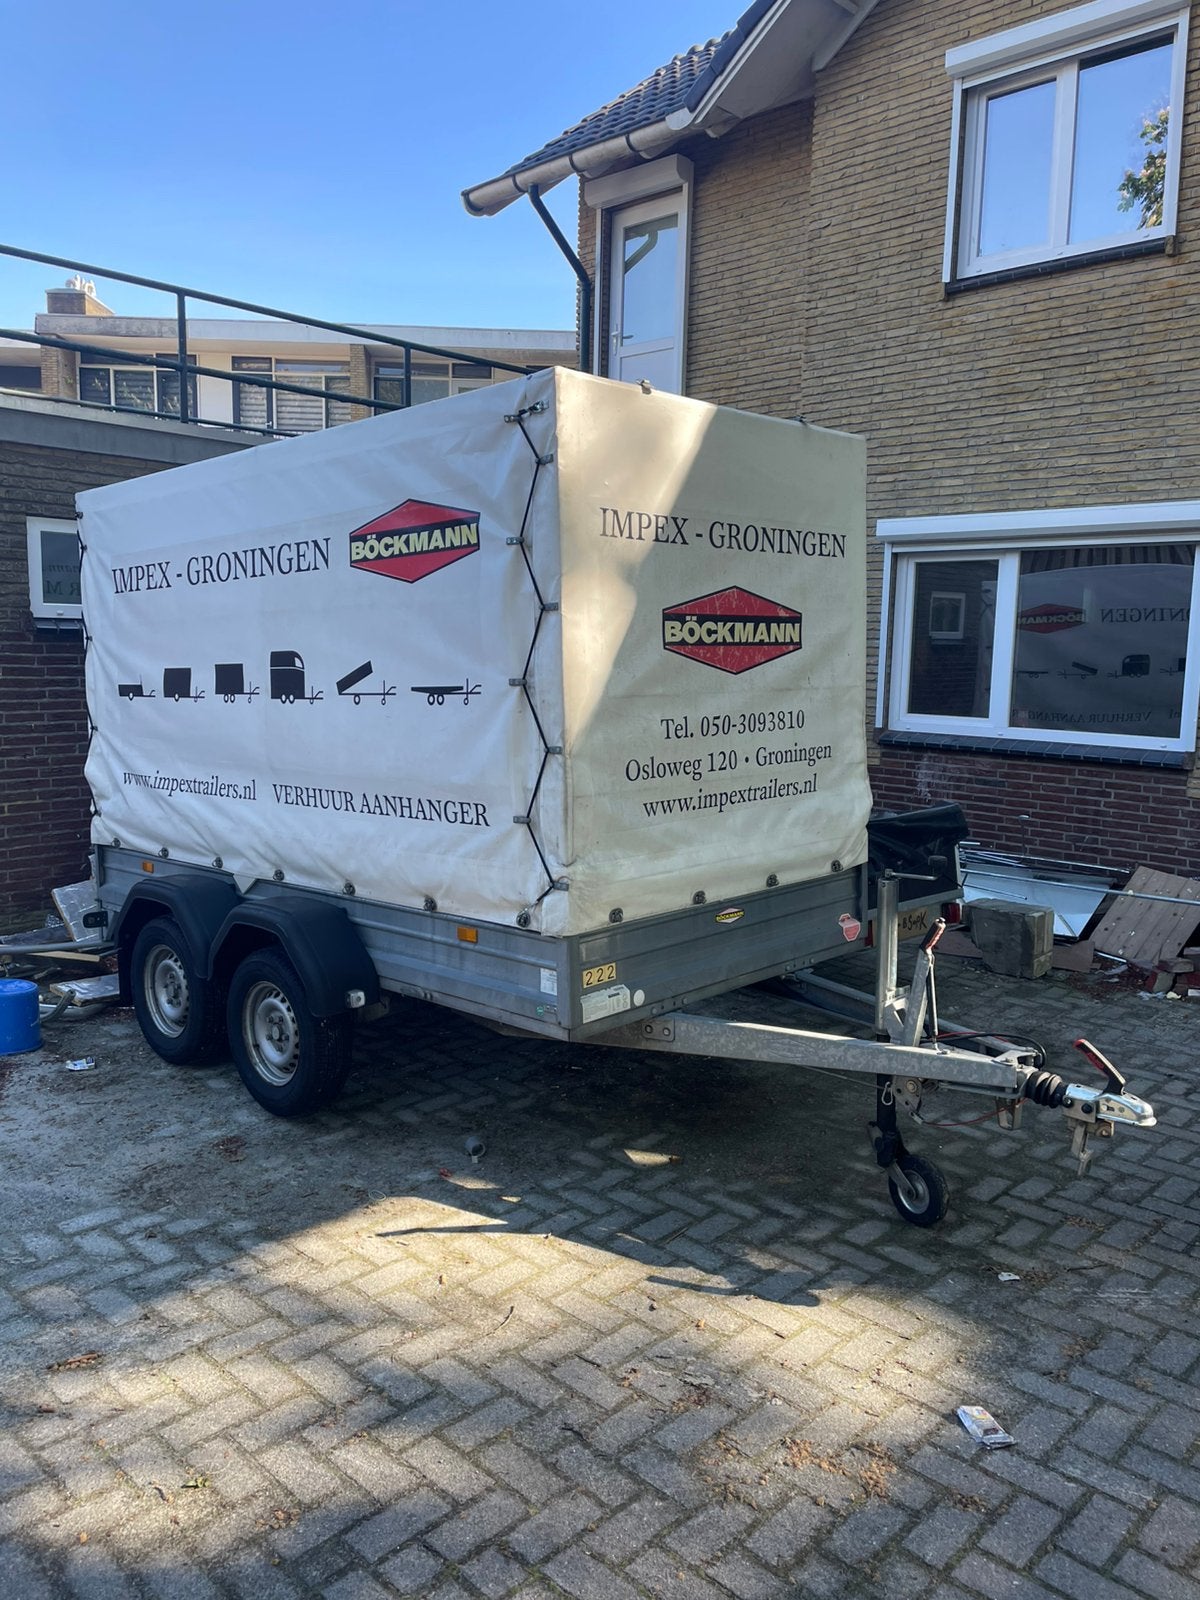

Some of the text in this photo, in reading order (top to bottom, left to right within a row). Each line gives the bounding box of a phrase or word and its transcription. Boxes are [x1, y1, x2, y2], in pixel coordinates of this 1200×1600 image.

[351, 523, 478, 562] BÖCKMANN
[600, 507, 689, 545] IMPEX
[709, 520, 847, 558] GRONINGEN
[112, 560, 172, 594] IMPEX
[187, 537, 331, 586] GRONINGEN
[664, 616, 800, 644] BÖCKMANN
[660, 709, 805, 740] Tel. 050-3093810
[625, 742, 832, 782] Osloweg 120 Groningen
[123, 770, 257, 802] www.impextrailers.nl
[272, 783, 490, 828] VERHUUR AANHANGER
[643, 773, 818, 817] www.impextrailers.nl
[585, 965, 615, 986] 222
